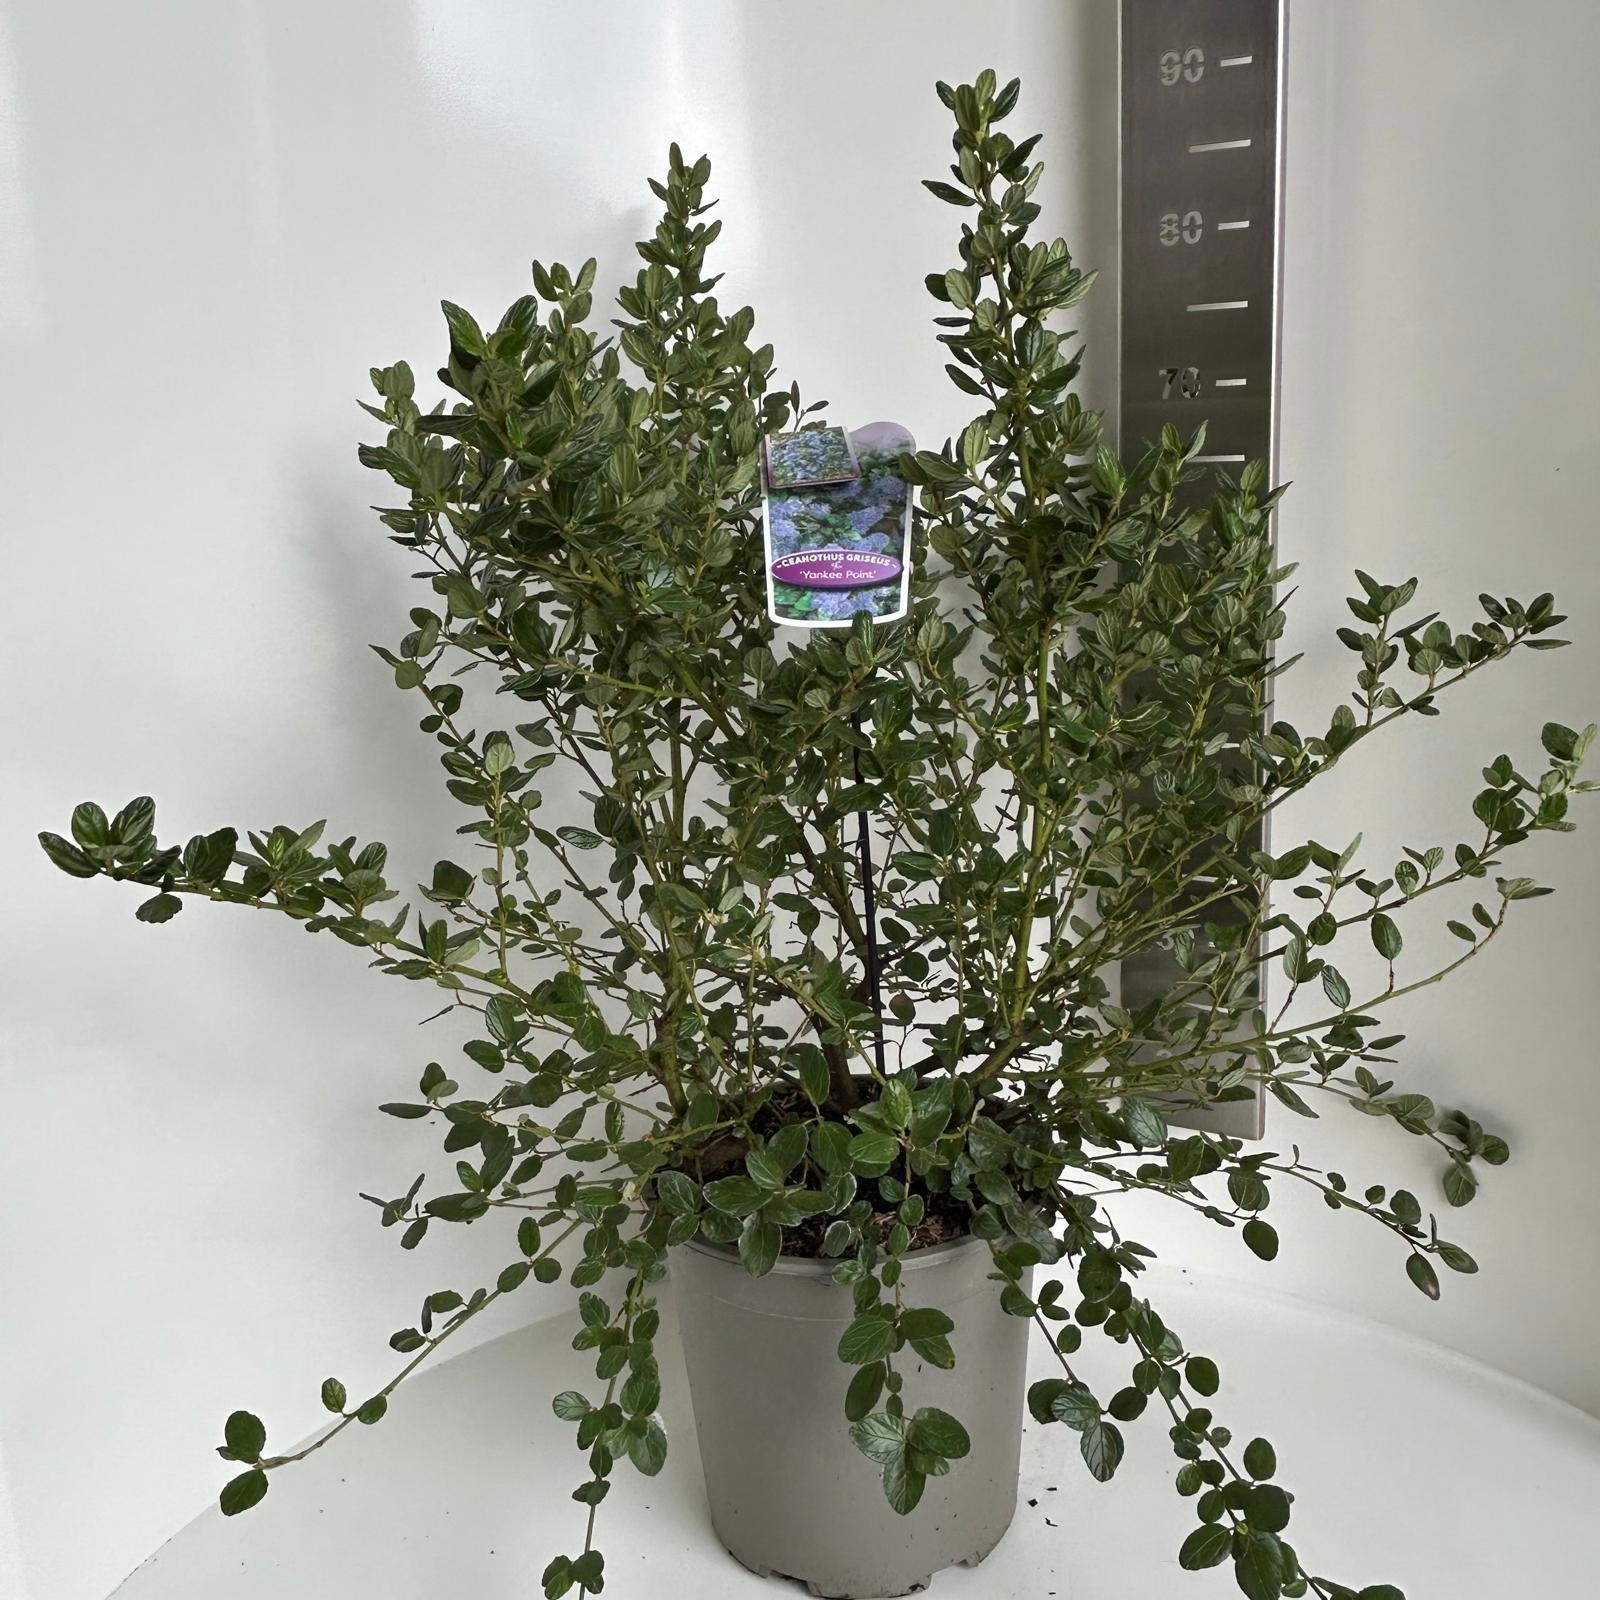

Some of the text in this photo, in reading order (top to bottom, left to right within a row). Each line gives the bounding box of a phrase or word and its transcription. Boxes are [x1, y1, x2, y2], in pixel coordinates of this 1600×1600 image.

[1159, 48, 1204, 86] 90
[1159, 211, 1203, 247] 80
[1158, 366, 1201, 400] 70
[781, 553, 891, 567] CEANOTHUS GRISEUS
